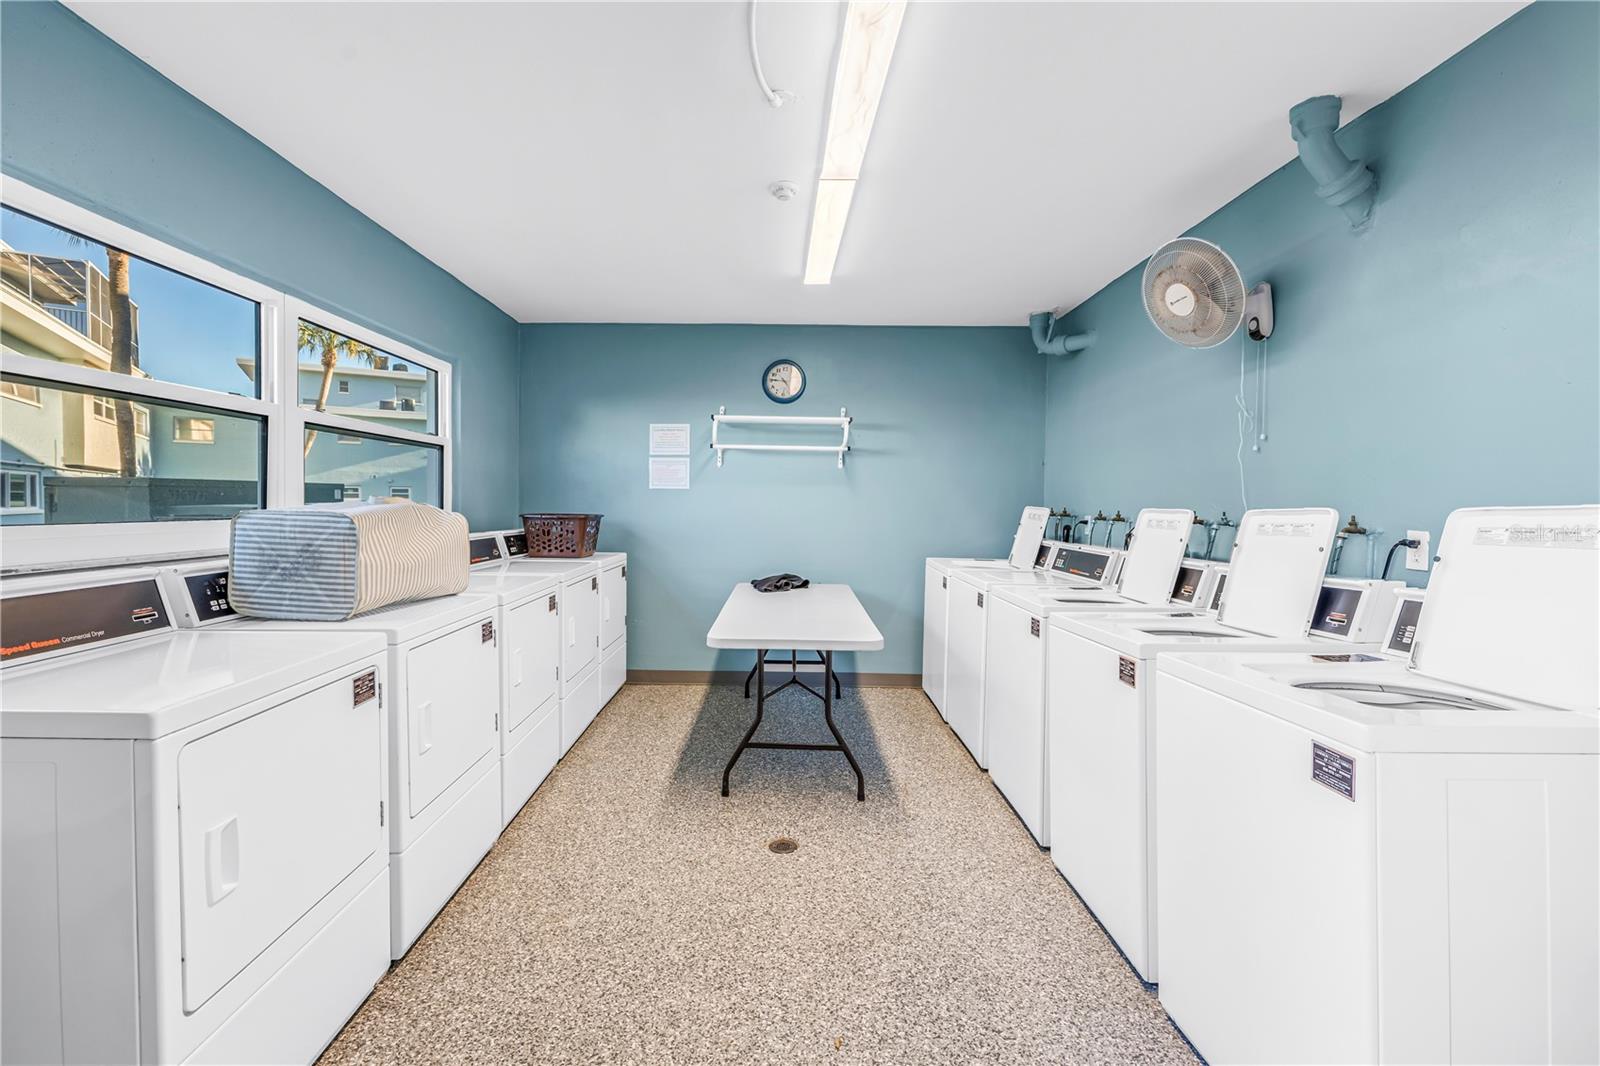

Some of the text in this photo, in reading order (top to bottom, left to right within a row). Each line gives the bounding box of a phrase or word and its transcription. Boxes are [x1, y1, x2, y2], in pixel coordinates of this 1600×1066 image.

[31, 639, 60, 648] Queen
[61, 631, 91, 643] Commercial
[91, 630, 104, 638] Dryer
